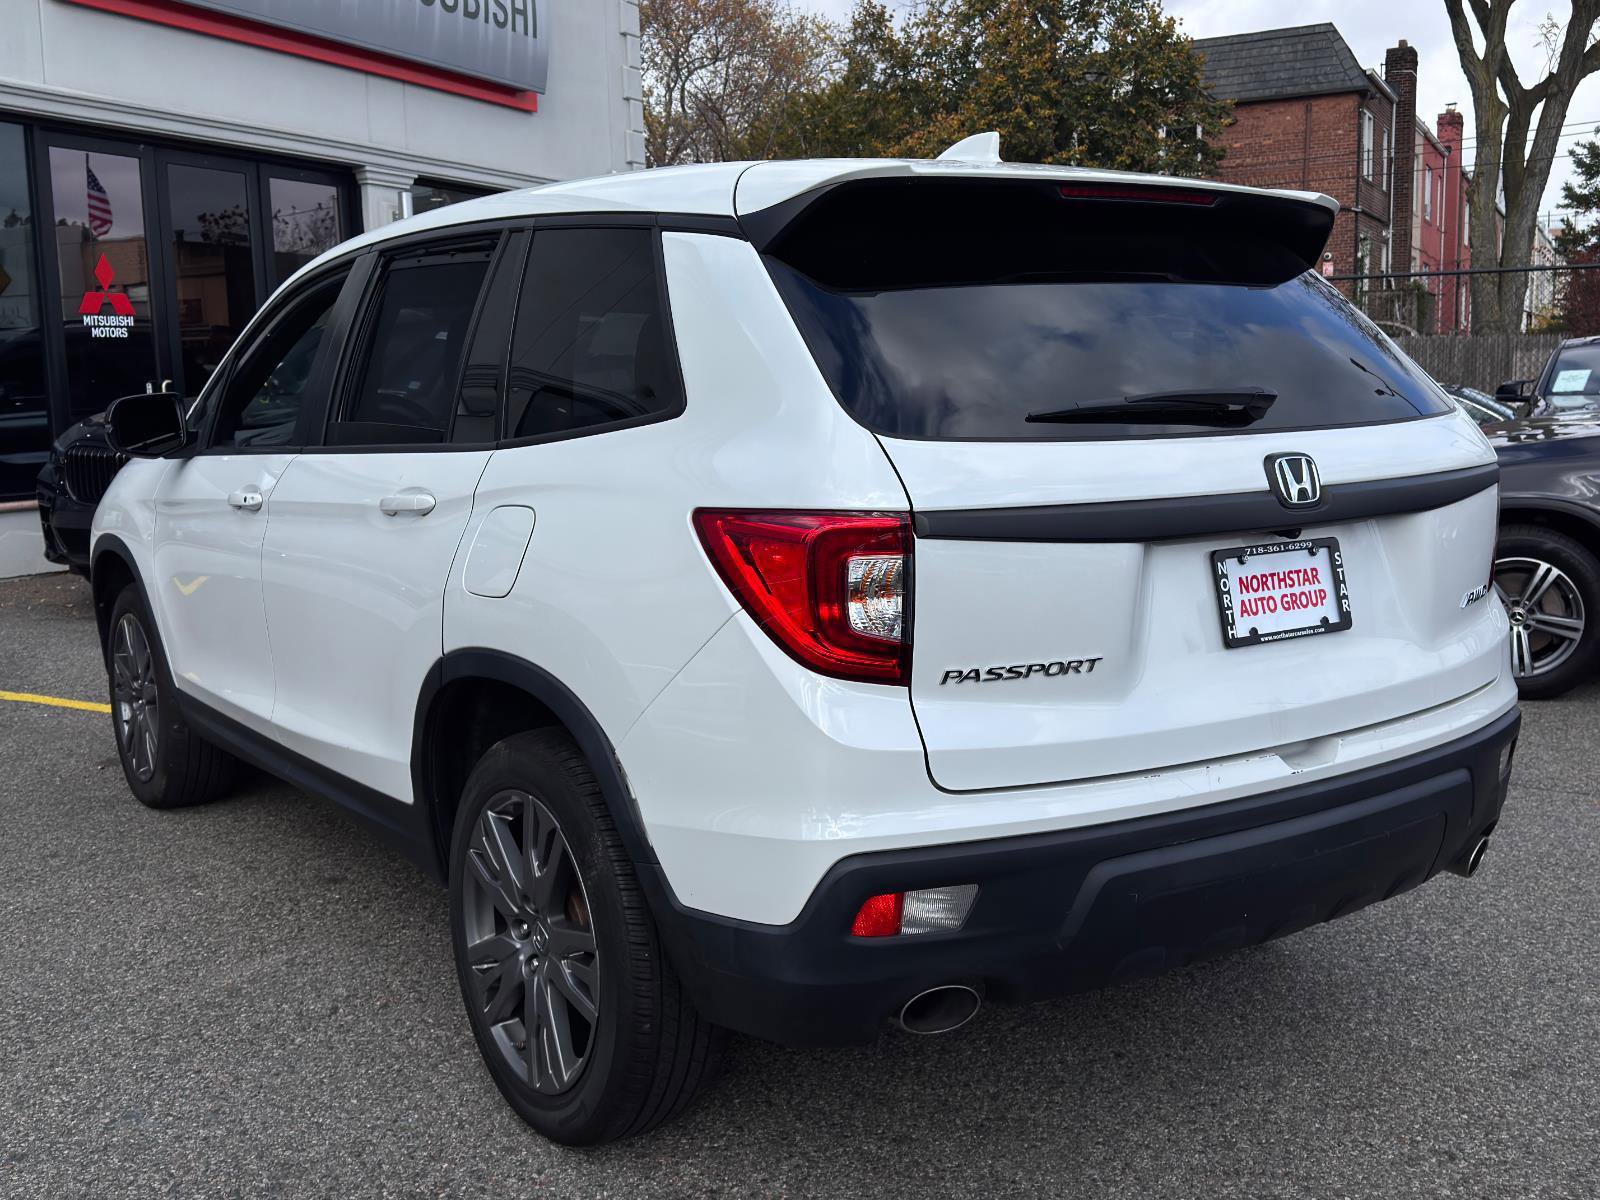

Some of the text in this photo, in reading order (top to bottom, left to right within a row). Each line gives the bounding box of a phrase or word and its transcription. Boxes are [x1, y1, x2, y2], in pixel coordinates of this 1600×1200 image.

[83, 314, 134, 327] MITSUBISHI
[91, 327, 128, 338] MOTORS
[1244, 541, 1312, 556] 718-361-6299
[1238, 567, 1322, 595] NORTHSTAR
[1334, 552, 1350, 612] STAR
[1217, 561, 1238, 640] NORTH
[1240, 588, 1328, 618] AUTO GROUP
[938, 657, 1104, 686] PASSPORT
